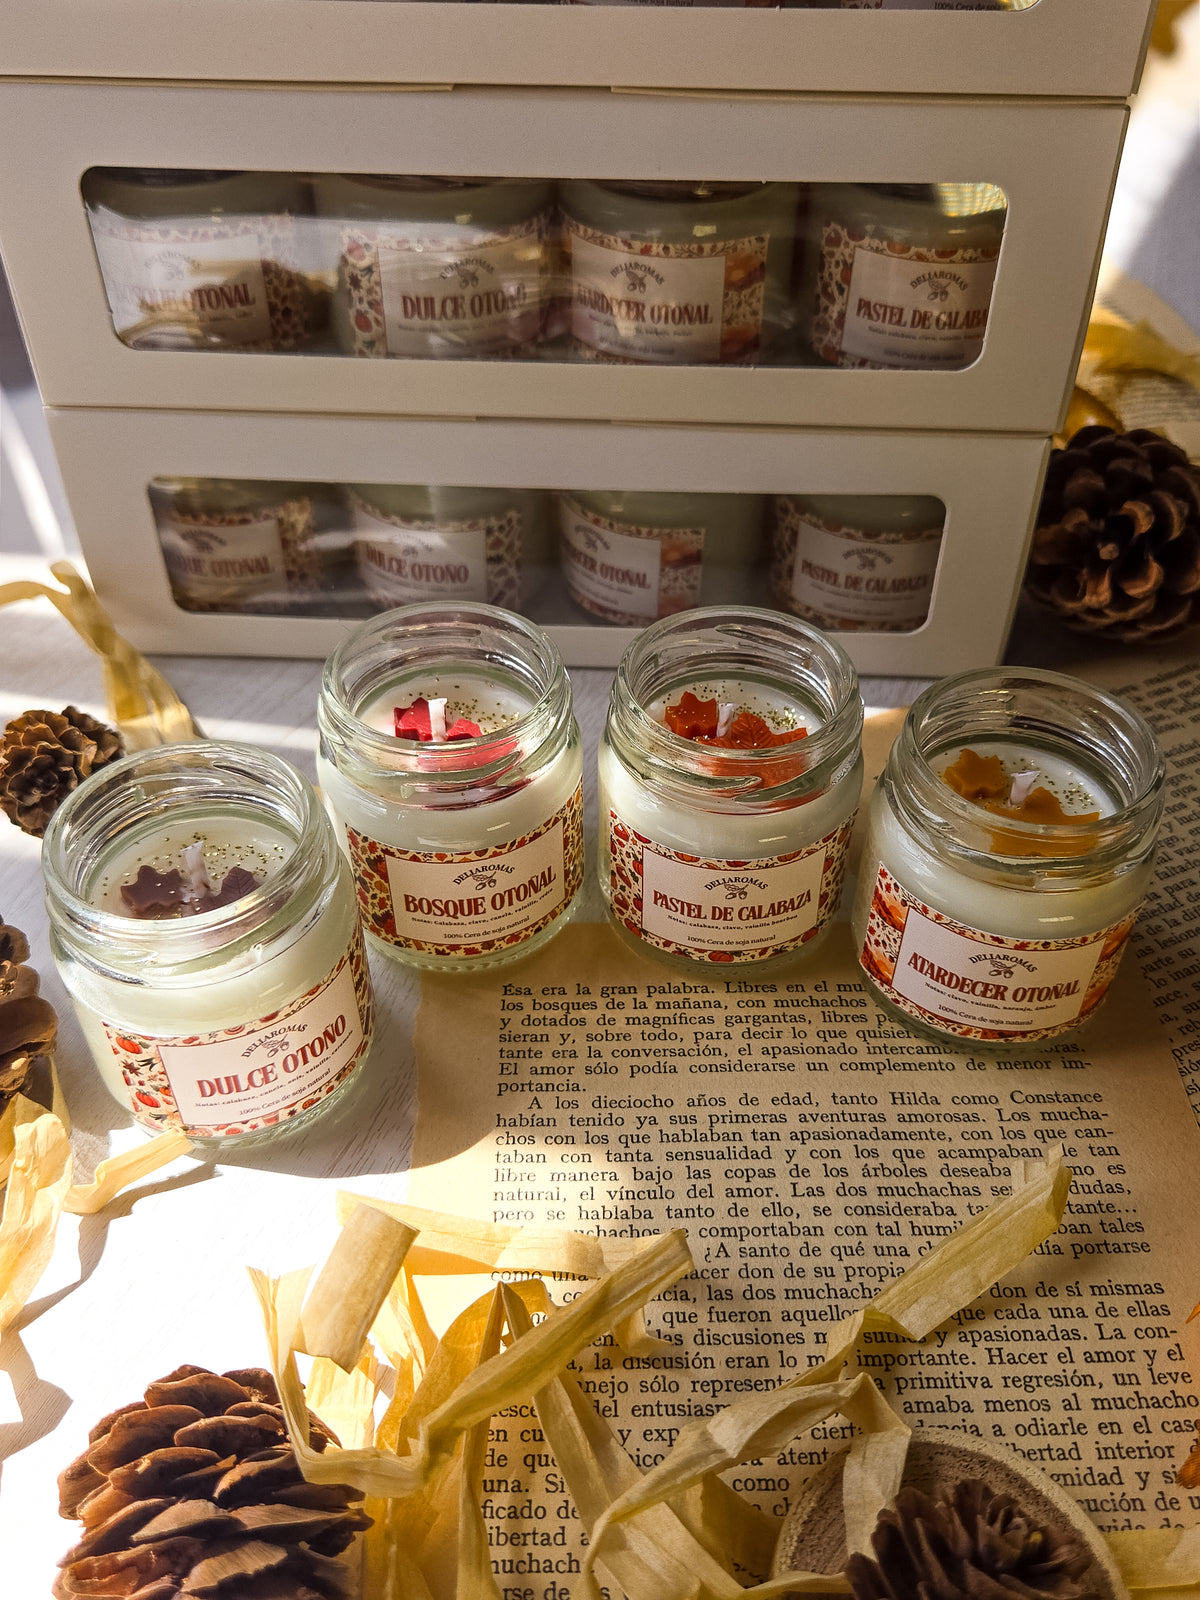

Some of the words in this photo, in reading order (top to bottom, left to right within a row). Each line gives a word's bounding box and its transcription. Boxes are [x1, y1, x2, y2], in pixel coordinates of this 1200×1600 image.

[403, 295, 465, 320] DULCE
[856, 298, 907, 327] PASTEL
[910, 310, 932, 329] DE
[844, 575, 862, 591] DE
[404, 894, 486, 919] BOSQUE
[491, 866, 556, 910] OTOÑAL
[653, 890, 707, 919] PASTEL
[711, 906, 733, 921] DE
[738, 889, 811, 921] CALABAZA
[492, 926, 506, 934] soja
[506, 916, 529, 928] natural
[751, 935, 775, 944] natural
[907, 952, 1008, 1000] ATARDECER
[1012, 980, 1080, 1002] OTOÑAL
[502, 983, 533, 996] Ésa
[541, 987, 567, 996] era
[576, 983, 592, 995] la
[600, 986, 638, 998] gran
[646, 982, 715, 998] palabra.
[723, 982, 777, 993] Libres
[786, 984, 806, 992] en
[814, 980, 829, 992] el
[500, 999, 524, 1011] los
[532, 999, 598, 1014] bosques
[606, 998, 625, 1010] de
[632, 998, 648, 1009] la
[655, 997, 728, 1010] mañana,
[737, 999, 766, 1008] con
[773, 995, 867, 1008] muchachos
[938, 1004, 958, 1016] 100%
[959, 1011, 977, 1022] Cera
[978, 1016, 987, 1024] de
[196, 1063, 278, 1097] DULCE
[282, 1015, 345, 1073] OTOÑO
[498, 1062, 518, 1075] El
[530, 1066, 575, 1075] amor
[585, 1062, 618, 1075] sólo
[629, 1061, 678, 1078] podía
[689, 1059, 795, 1073] considerarse
[806, 1062, 829, 1071] un
[840, 1058, 955, 1075] complemento
[966, 1058, 987, 1071] de
[996, 1059, 1051, 1070] menor
[1061, 1056, 1091, 1069] im-
[497, 1079, 586, 1096] portancia.
[527, 1096, 543, 1109] A
[555, 1096, 579, 1109] los
[592, 1094, 674, 1109] dieciocho
[687, 1094, 726, 1108] años
[739, 1093, 759, 1106] de
[771, 1092, 819, 1107] edad,
[831, 1092, 878, 1105] tanto
[889, 1091, 941, 1106] Hilda
[951, 1095, 1000, 1105] como
[1010, 1090, 1103, 1105] Constance
[496, 1113, 557, 1127] habían
[568, 1112, 624, 1127] tenido
[633, 1116, 659, 1130] ya
[669, 1115, 697, 1125] sus
[708, 1110, 787, 1126] primeras
[798, 1110, 887, 1123] aventuras
[897, 1113, 986, 1124] amorosas.
[995, 1108, 1031, 1122] Los
[1039, 1106, 1108, 1121] mucha-
[705, 1242, 731, 1263] ¿A
[739, 1243, 791, 1258] santo
[799, 1241, 821, 1257] de
[830, 1240, 865, 1262] qué
[873, 1245, 910, 1257] una
[1070, 1239, 1151, 1260] portarse
[990, 1287, 1028, 1299] don
[1035, 1281, 1059, 1298] de
[1065, 1281, 1083, 1297] sí
[1089, 1279, 1165, 1296] mismas
[951, 1308, 986, 1324] que
[996, 1303, 1042, 1320] cada
[1048, 1307, 1088, 1319] una
[1095, 1301, 1119, 1318] de
[1127, 1300, 1171, 1317] ellas
[936, 1329, 948, 1346] y
[958, 1324, 1087, 1344] apasionadas.
[1094, 1323, 1126, 1340] La
[1134, 1326, 1177, 1340] con-
[856, 1349, 976, 1372] importante.
[984, 1347, 1048, 1365] Hacer
[1057, 1346, 1075, 1364] el
[1083, 1350, 1135, 1363] amor
[1144, 1349, 1157, 1365] y
[1167, 1343, 1185, 1361] el
[895, 1372, 993, 1395] primitiva
[1001, 1369, 1103, 1393] regresión,
[1112, 1373, 1141, 1386] un
[1151, 1368, 1192, 1385] leve
[903, 1395, 974, 1414] amaba
[983, 1399, 1051, 1413] menos
[1062, 1393, 1082, 1411] al
[1015, 1417, 1088, 1437] odiarle
[1098, 1422, 1123, 1435] en
[1133, 1415, 1153, 1434] el
[1095, 1442, 1175, 1460] interior
[732, 1478, 790, 1492] como
